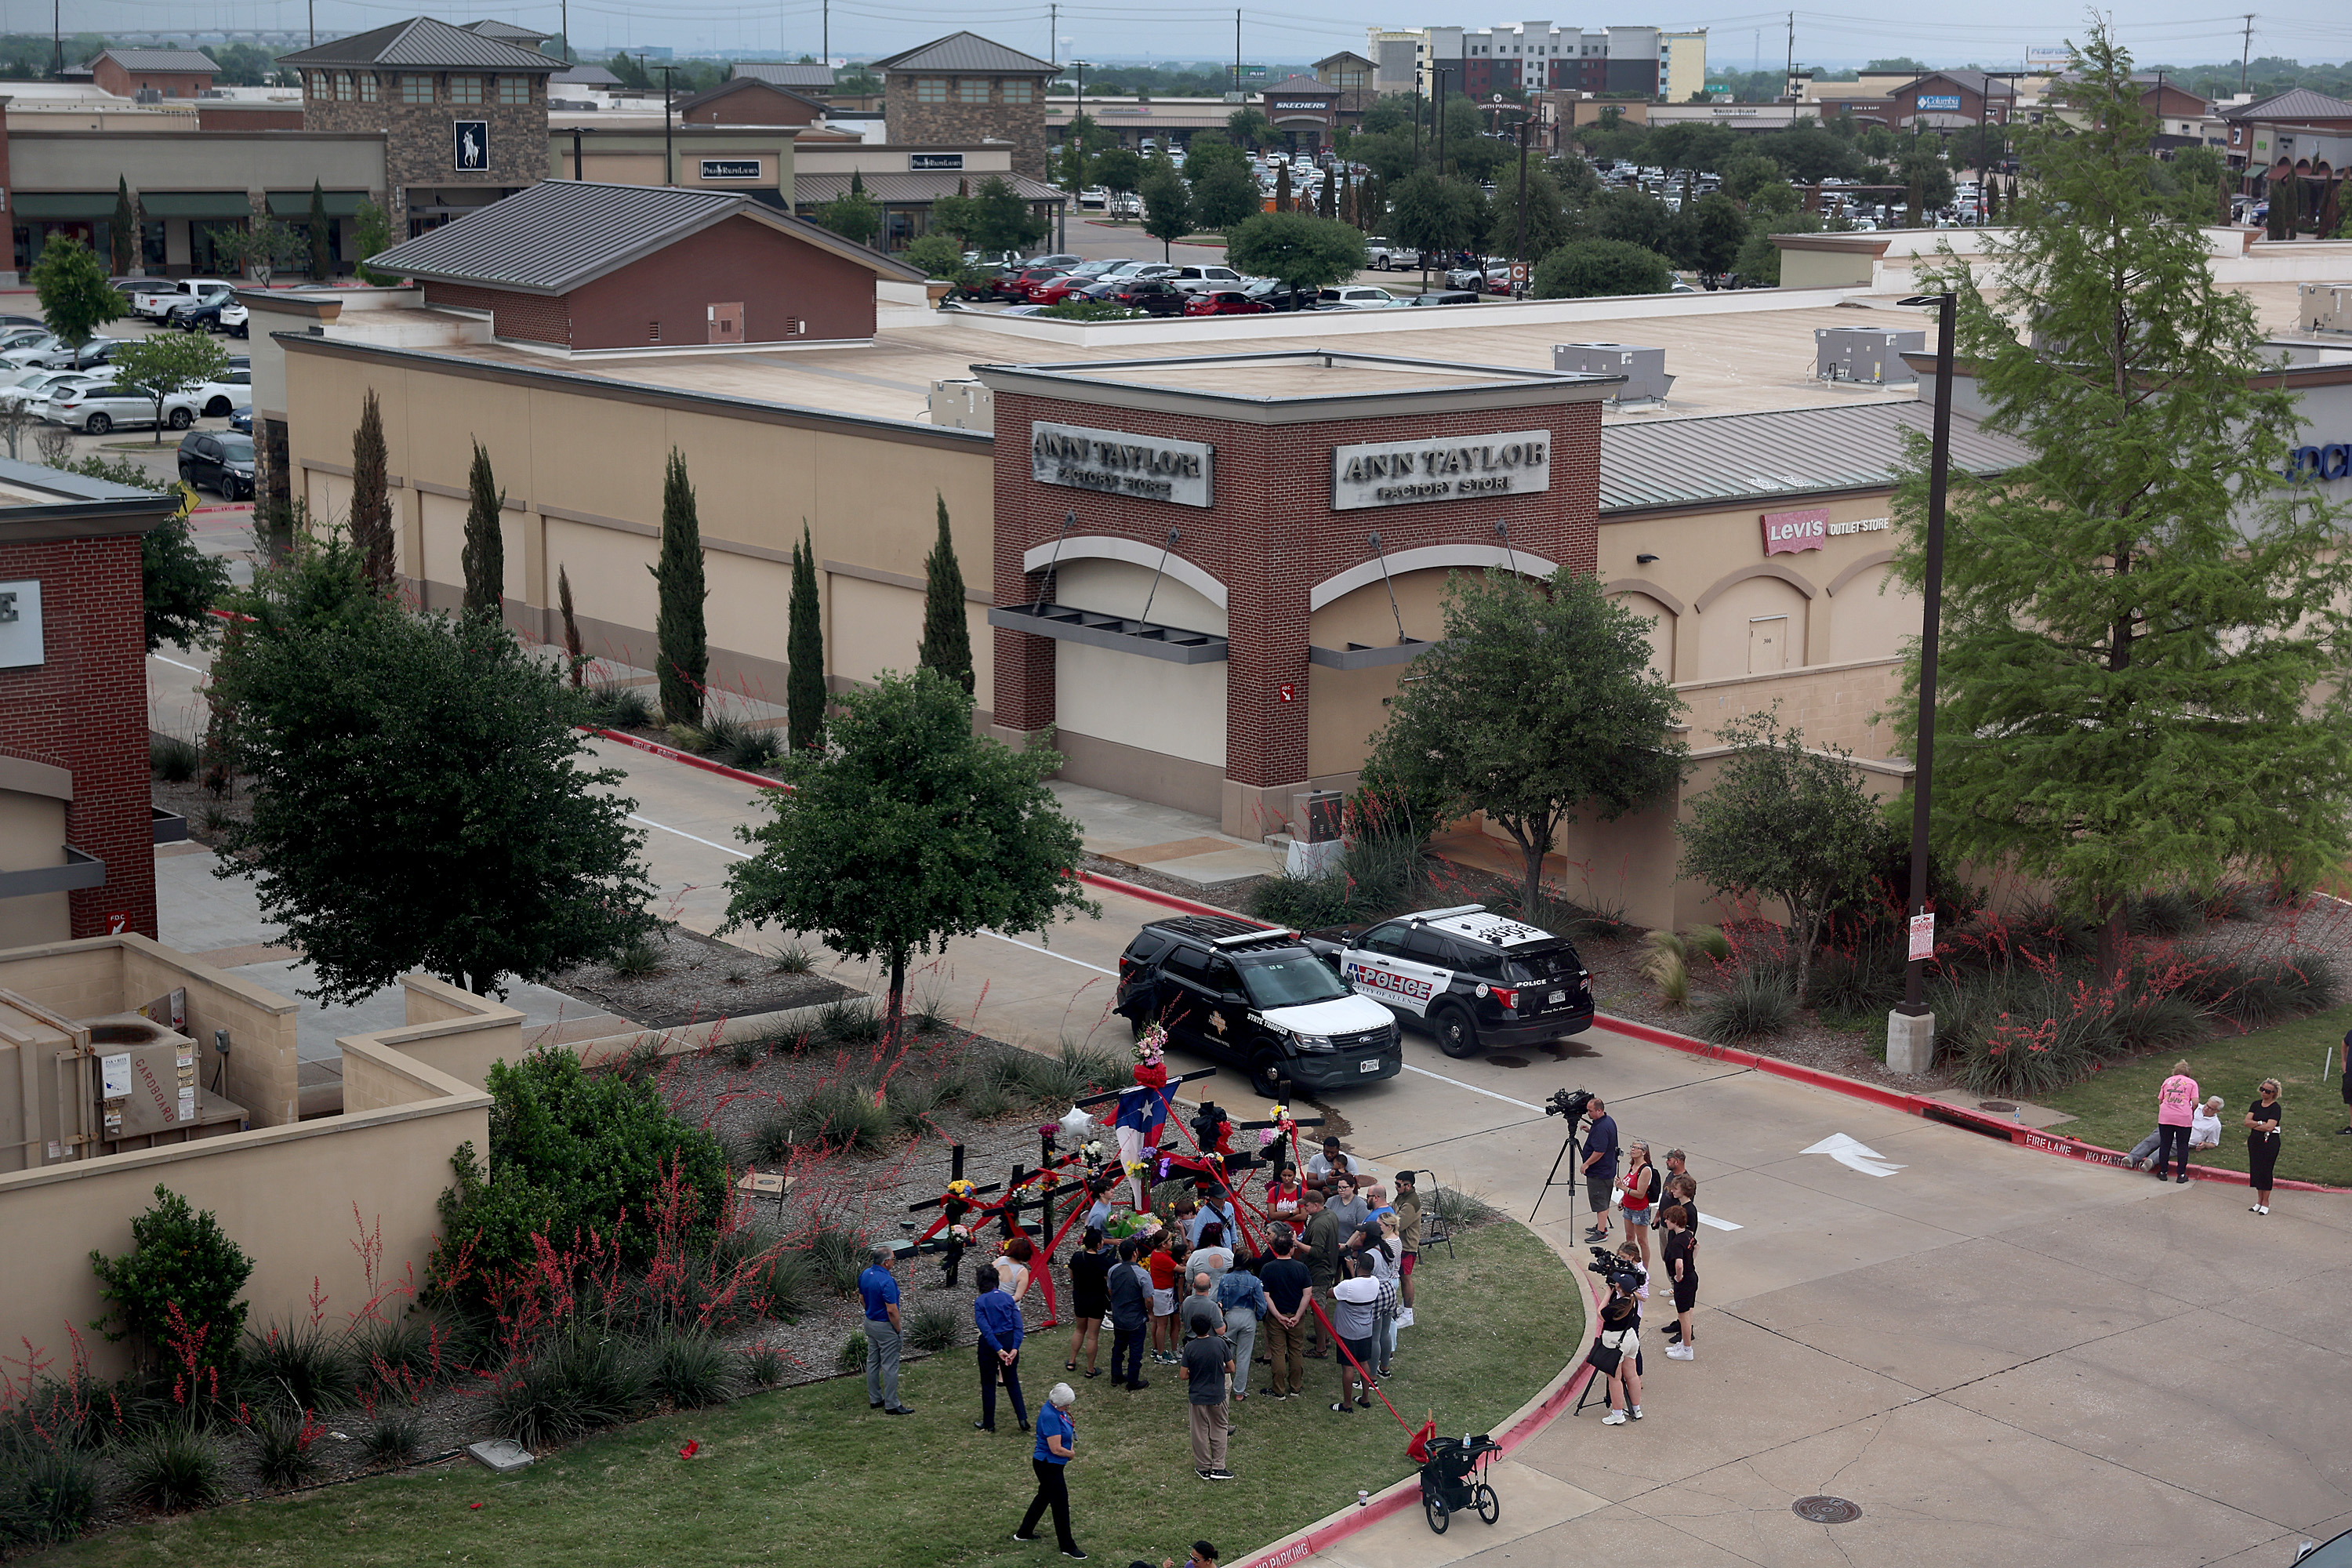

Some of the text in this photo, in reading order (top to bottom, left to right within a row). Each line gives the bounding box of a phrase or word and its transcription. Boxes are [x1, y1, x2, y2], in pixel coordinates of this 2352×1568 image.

[1927, 96, 1958, 106] Columbia
[1513, 266, 1524, 279] C
[1033, 432, 1200, 478] ANN TAYLOR
[1343, 441, 1548, 481] ANN TAYLOR
[1057, 468, 1171, 495] FACTORY STORE
[1379, 480, 1452, 499] FACTORY
[1829, 517, 1889, 535] OUTLET STORE
[1357, 985, 1413, 1004] CITY OF ALLEN
[1363, 968, 1430, 1000] POLICE
[1515, 979, 1547, 988] POLICE
[1247, 1013, 1289, 1036] STATE TROOPER
[136, 1058, 174, 1123] CARDBOARD
[2026, 1134, 2045, 1149] FIRE
[2047, 1141, 2072, 1156] LANE
[2085, 1151, 2099, 1163] NO
[1269, 1543, 1308, 1568] PARKING
